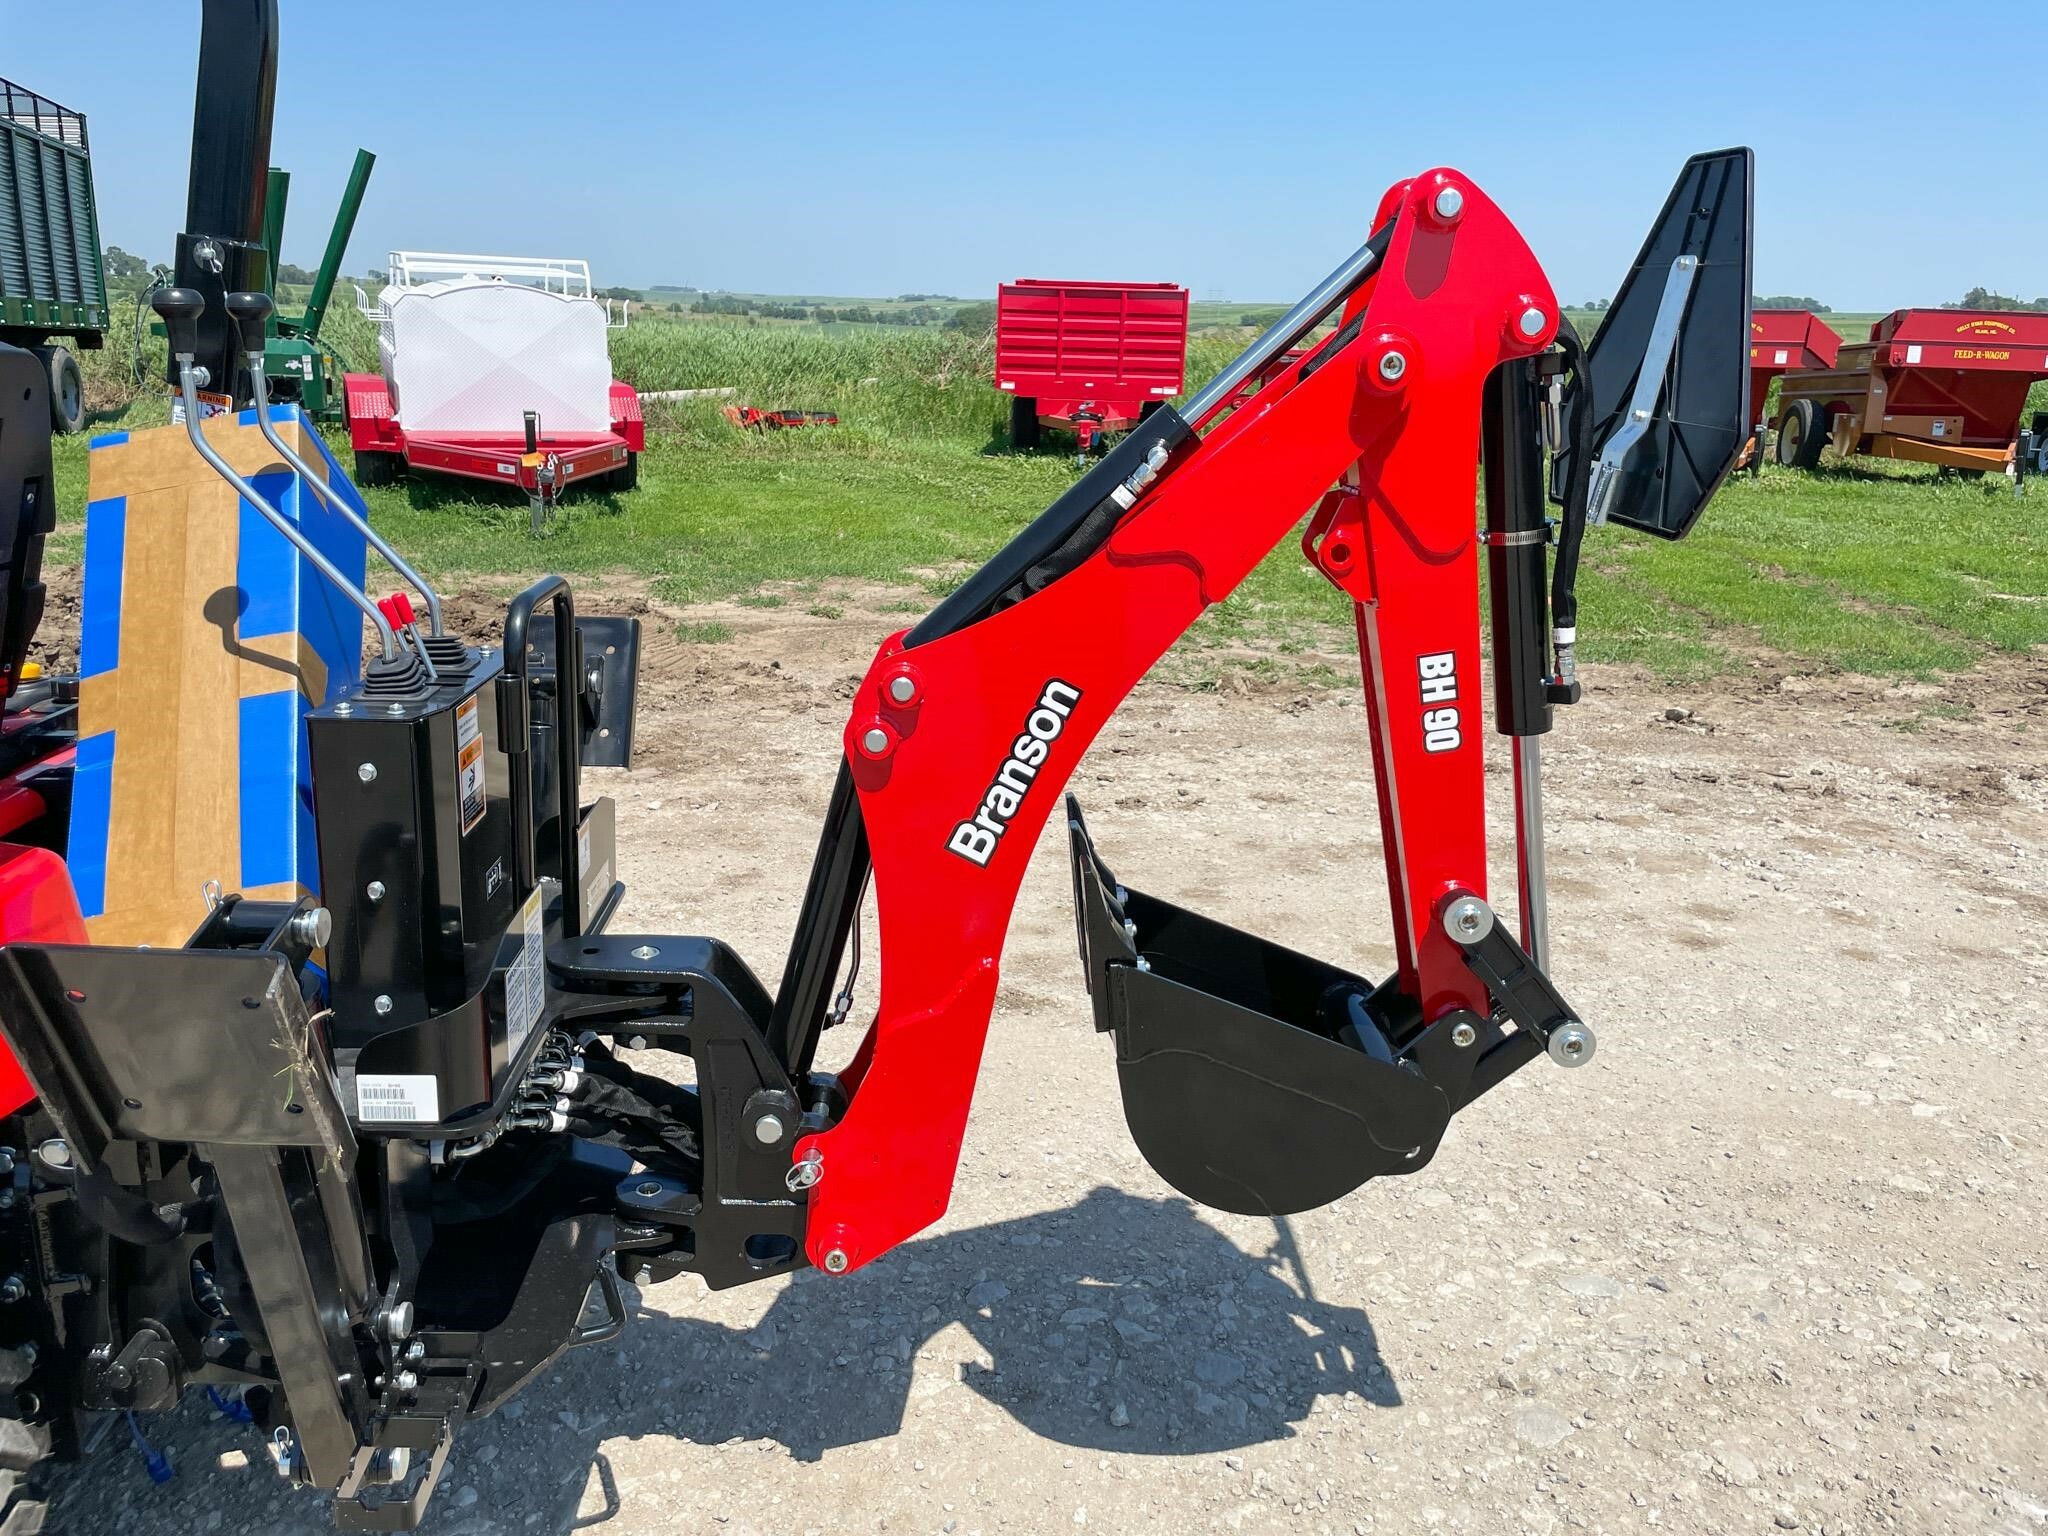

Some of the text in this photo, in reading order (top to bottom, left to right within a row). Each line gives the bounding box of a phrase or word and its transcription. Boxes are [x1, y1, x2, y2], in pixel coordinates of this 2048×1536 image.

[1953, 349, 2010, 360] FEED-R-WAGON
[197, 392, 226, 405] ARNING
[1419, 652, 1461, 752] BH 90
[948, 680, 1081, 866] Branson
